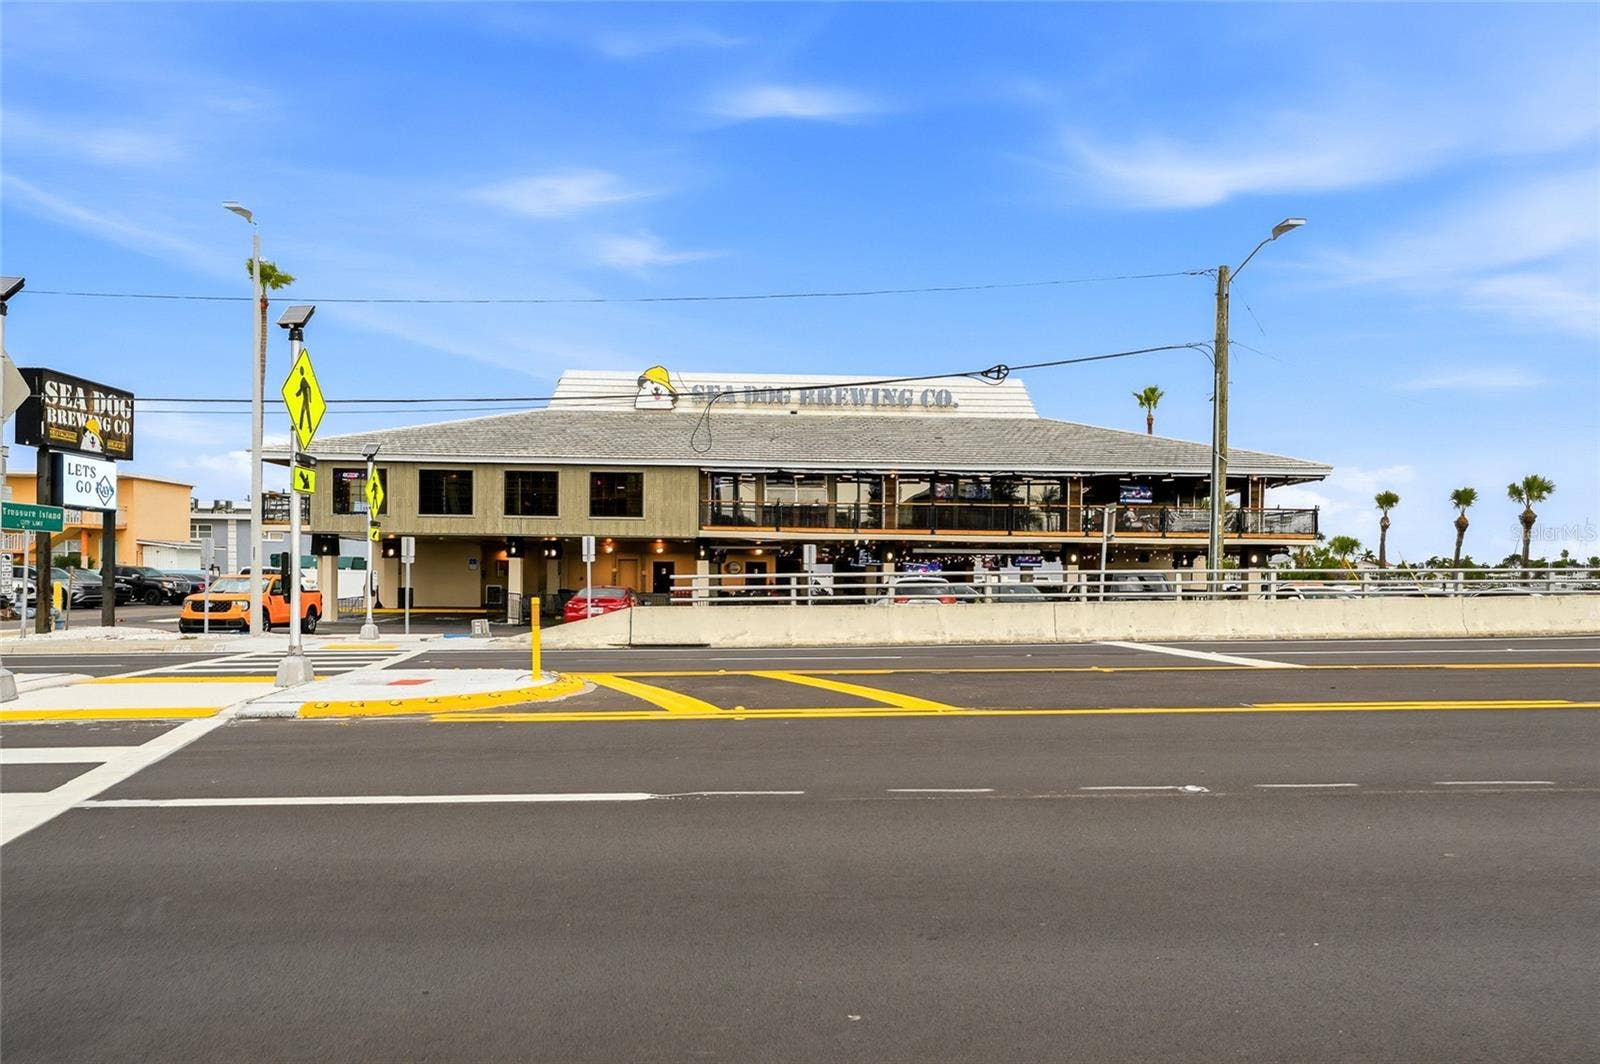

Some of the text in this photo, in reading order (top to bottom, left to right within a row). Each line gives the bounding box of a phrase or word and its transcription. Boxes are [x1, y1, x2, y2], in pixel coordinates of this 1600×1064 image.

[45, 381, 132, 419] SEA DOG
[692, 385, 959, 409] SEA DOG BREWING CO.
[114, 419, 132, 435] CO.
[68, 462, 96, 479] LETS
[76, 480, 91, 493] GO
[3, 507, 61, 520] Treasure Island
